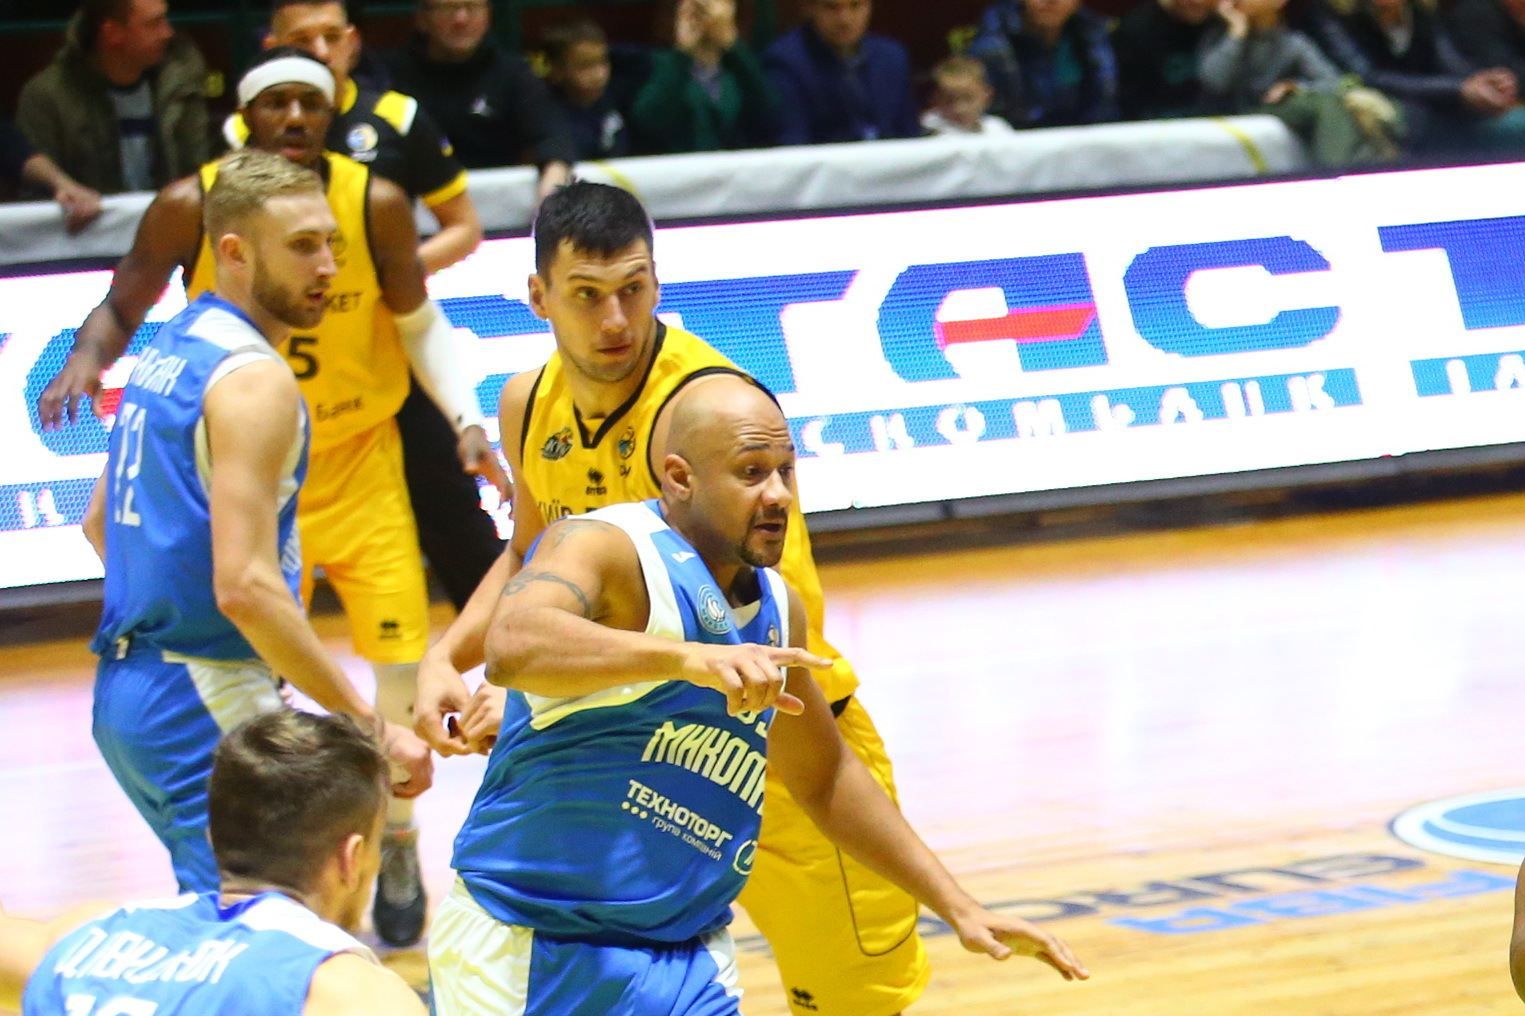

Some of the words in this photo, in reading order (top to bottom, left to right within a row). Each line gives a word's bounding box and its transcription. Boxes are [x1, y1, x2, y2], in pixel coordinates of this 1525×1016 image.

[801, 371, 1339, 458] СКОМБАНК
[640, 720, 768, 817] МИКОЛ
[628, 778, 734, 849] ТЕХНОТОРГ
[651, 815, 682, 838] група
